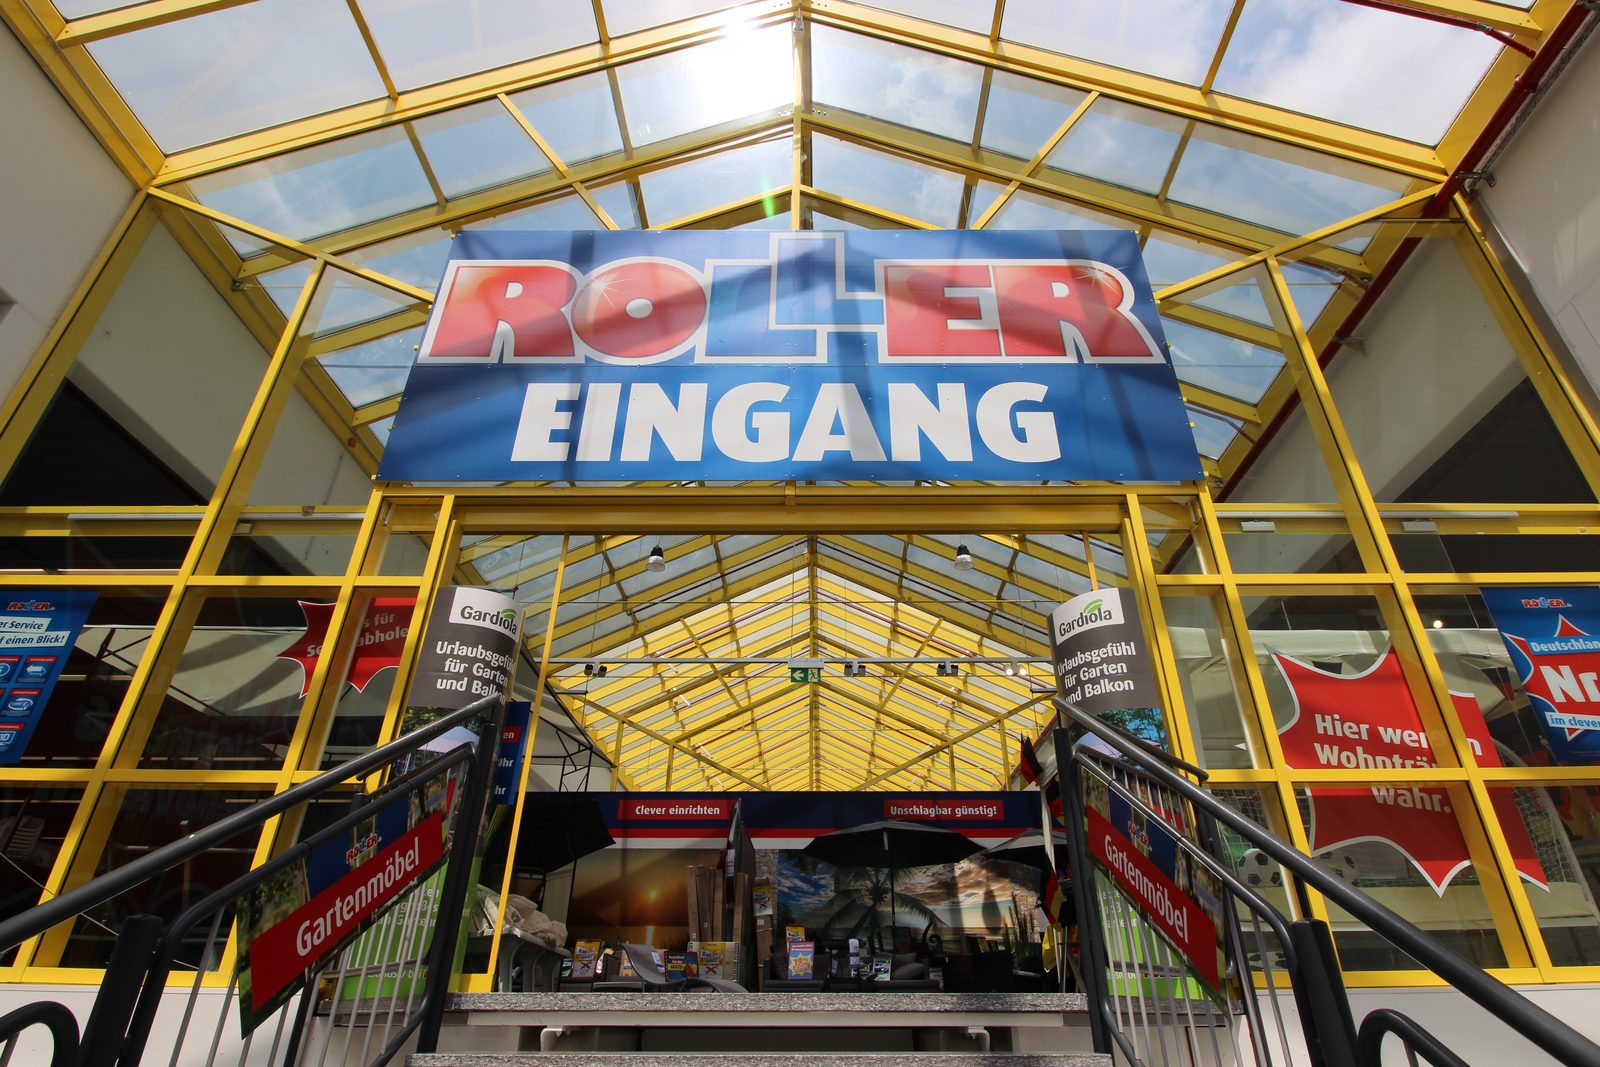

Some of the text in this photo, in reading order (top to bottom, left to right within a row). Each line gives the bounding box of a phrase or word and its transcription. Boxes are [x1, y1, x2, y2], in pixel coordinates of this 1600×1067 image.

[416, 231, 1168, 366] ROLLER
[510, 381, 1062, 463] EINGANG
[9, 620, 44, 630] Service
[374, 612, 395, 626] für
[460, 605, 518, 636] Gardiola
[1059, 608, 1113, 637] Gardiola
[5, 636, 34, 645] einen
[36, 635, 65, 644] Blick!
[1530, 638, 1600, 652] Deutschlan
[444, 657, 508, 686] für Garten
[1057, 641, 1136, 677] Urlaubsgefühl
[436, 677, 468, 692] und
[1064, 662, 1128, 689] für Garten
[1084, 678, 1135, 698] Balkon
[1314, 713, 1370, 741] Hier
[1550, 715, 1566, 726] im
[635, 805, 720, 815] Clever einrichten
[890, 805, 998, 817] Unschlagbar günstig!
[296, 836, 419, 957] Gartenmöbel
[1104, 834, 1189, 944] Gartenmöbel
